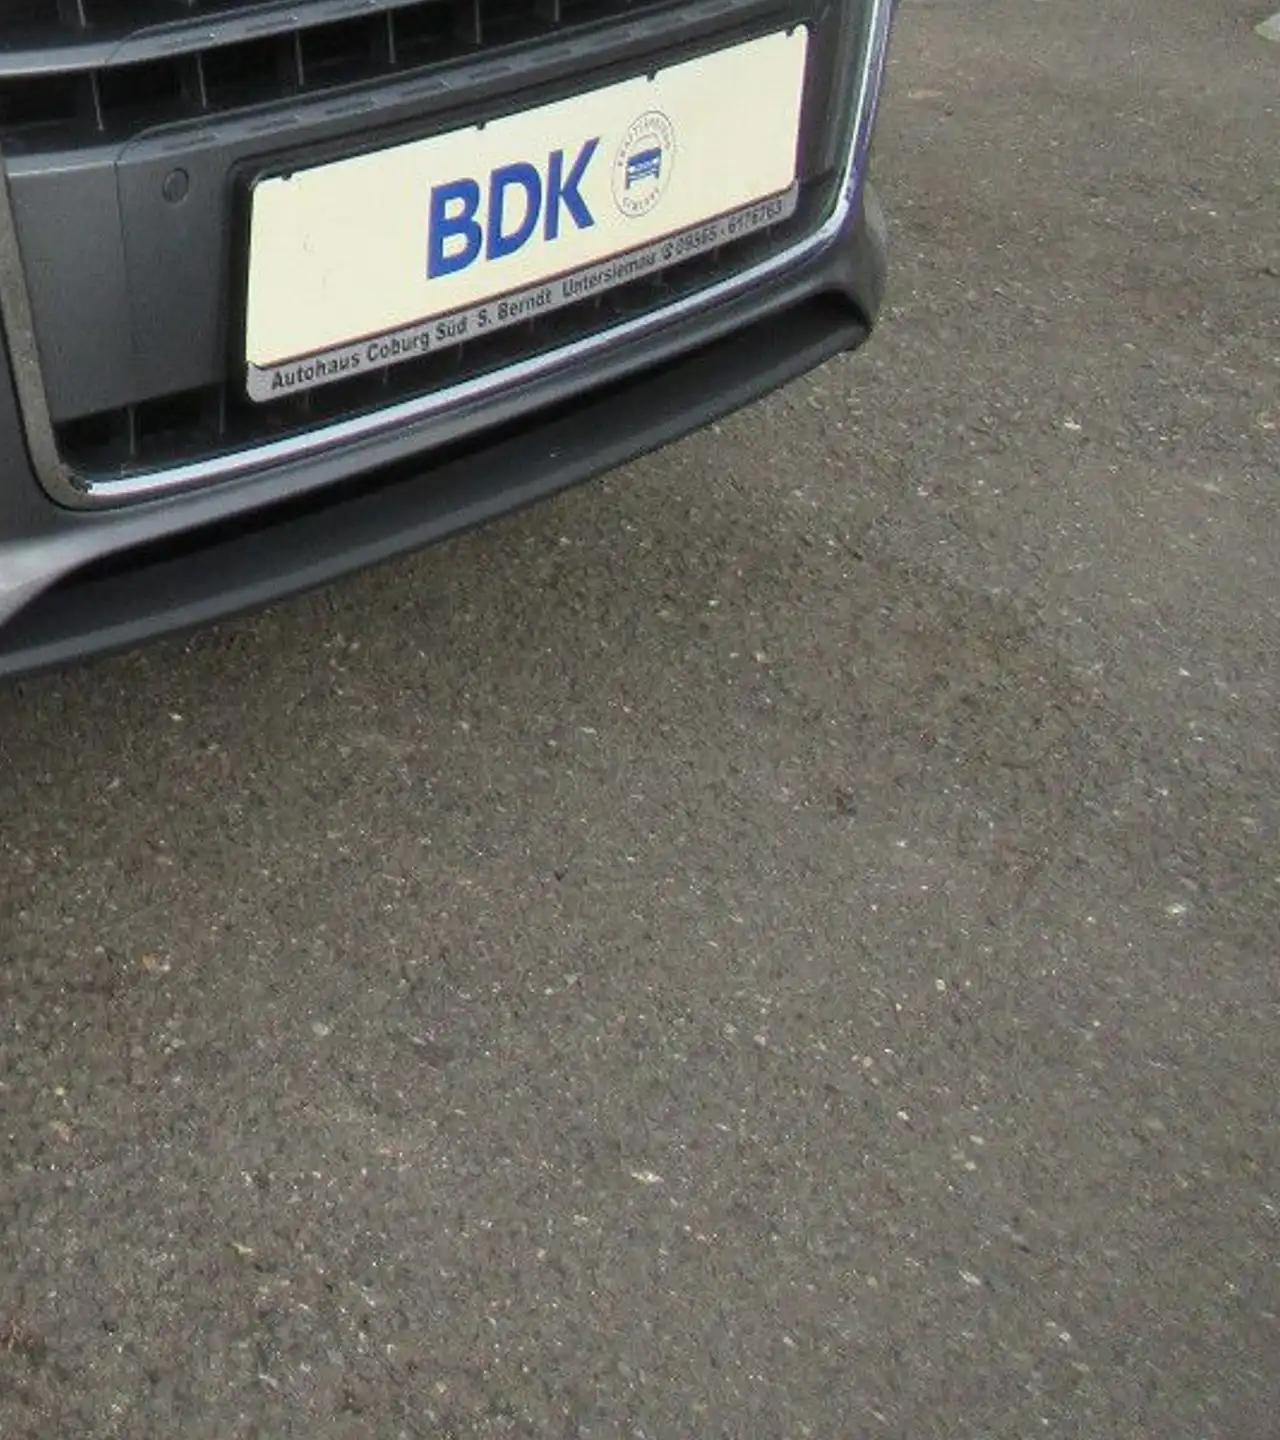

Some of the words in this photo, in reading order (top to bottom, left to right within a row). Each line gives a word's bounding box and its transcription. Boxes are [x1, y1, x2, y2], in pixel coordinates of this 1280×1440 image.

[426, 136, 600, 280] BDK
[271, 352, 360, 390] Autohaus
[367, 331, 430, 362] Coburg
[477, 309, 492, 327] S.
[498, 287, 553, 319] Berndt
